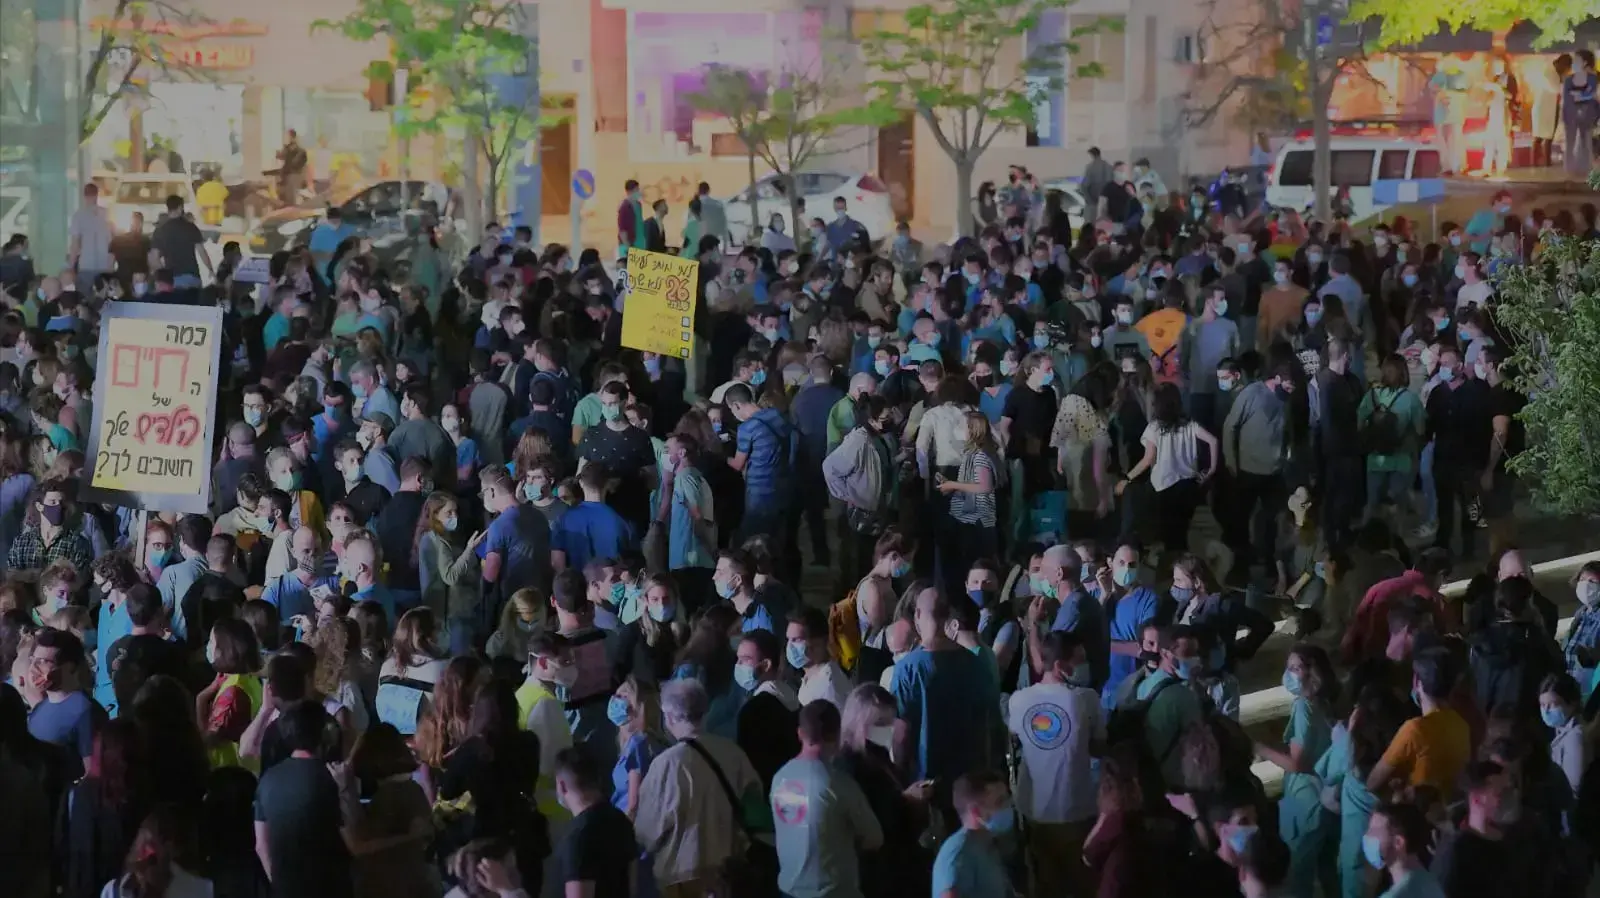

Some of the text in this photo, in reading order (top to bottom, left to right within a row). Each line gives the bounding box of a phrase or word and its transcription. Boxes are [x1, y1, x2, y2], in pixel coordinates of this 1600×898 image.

[665, 274, 690, 302] 26
[166, 324, 207, 346] כמה
[112, 343, 190, 393] חיים
[152, 392, 172, 407] של
[106, 404, 200, 448] הילדים שלך
[96, 448, 193, 479] חשובים לך?
